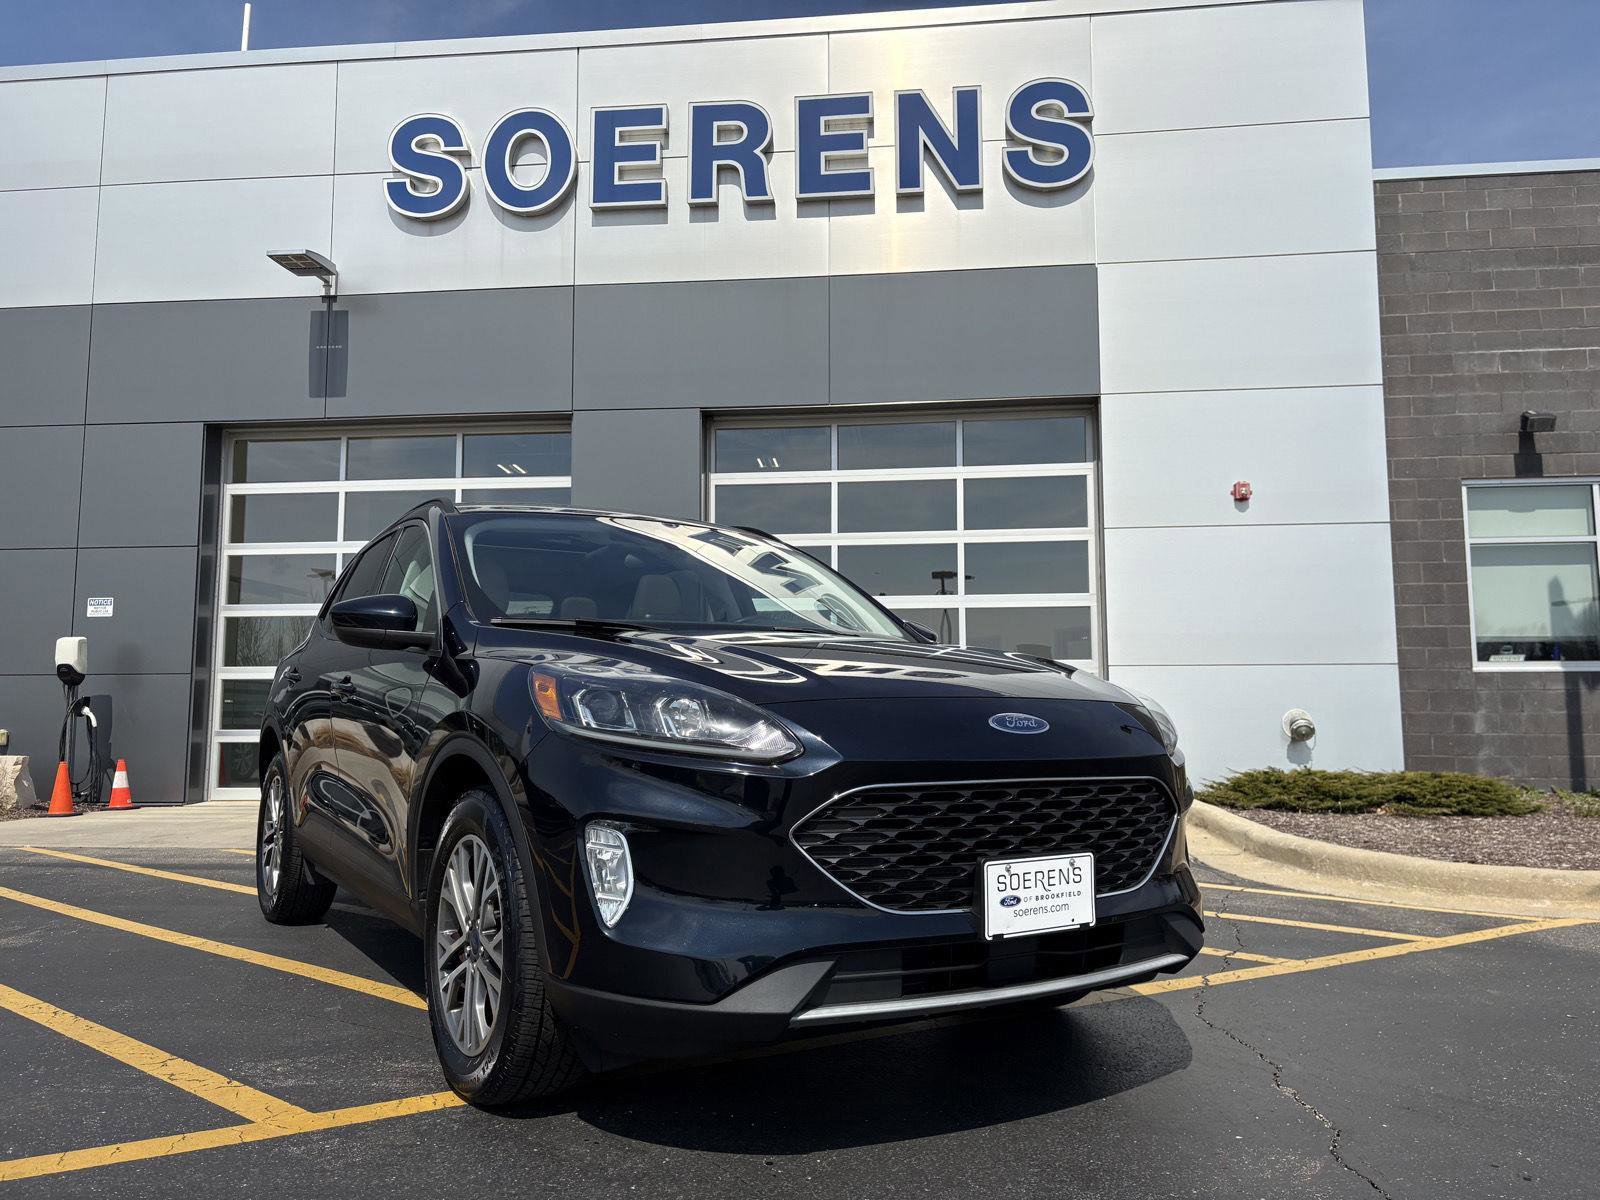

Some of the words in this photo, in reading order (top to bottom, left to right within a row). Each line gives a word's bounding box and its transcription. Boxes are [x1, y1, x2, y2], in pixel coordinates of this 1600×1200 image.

[382, 77, 1096, 220] SOERENS
[997, 866, 1082, 892] SOERENS
[1035, 891, 1082, 902] BROOKFIELD
[1013, 903, 1070, 918] soerens.com
